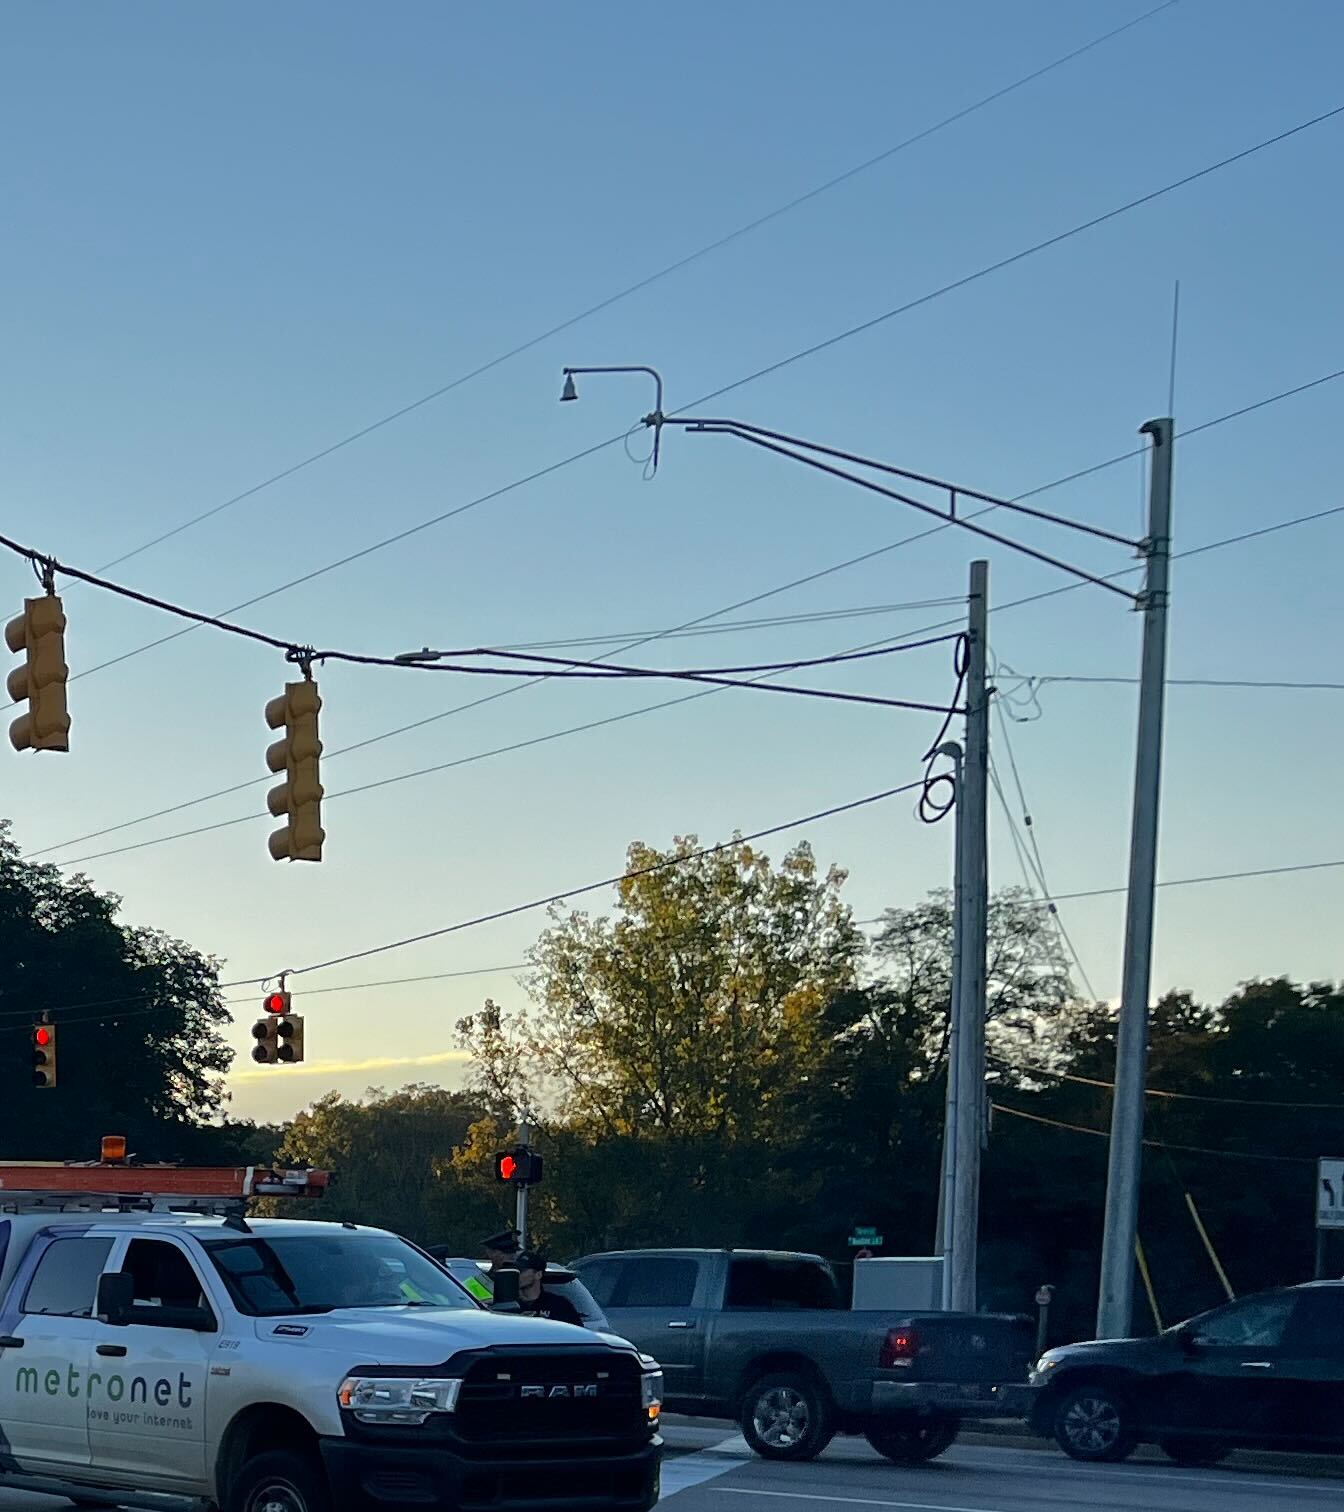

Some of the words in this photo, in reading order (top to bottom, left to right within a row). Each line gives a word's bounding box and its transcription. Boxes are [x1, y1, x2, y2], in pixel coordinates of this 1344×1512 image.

[16, 1363, 192, 1408] metronet
[520, 1385, 598, 1399] RAM
[88, 1407, 109, 1421] love
[113, 1411, 140, 1425] your
[143, 1413, 193, 1430] internet
